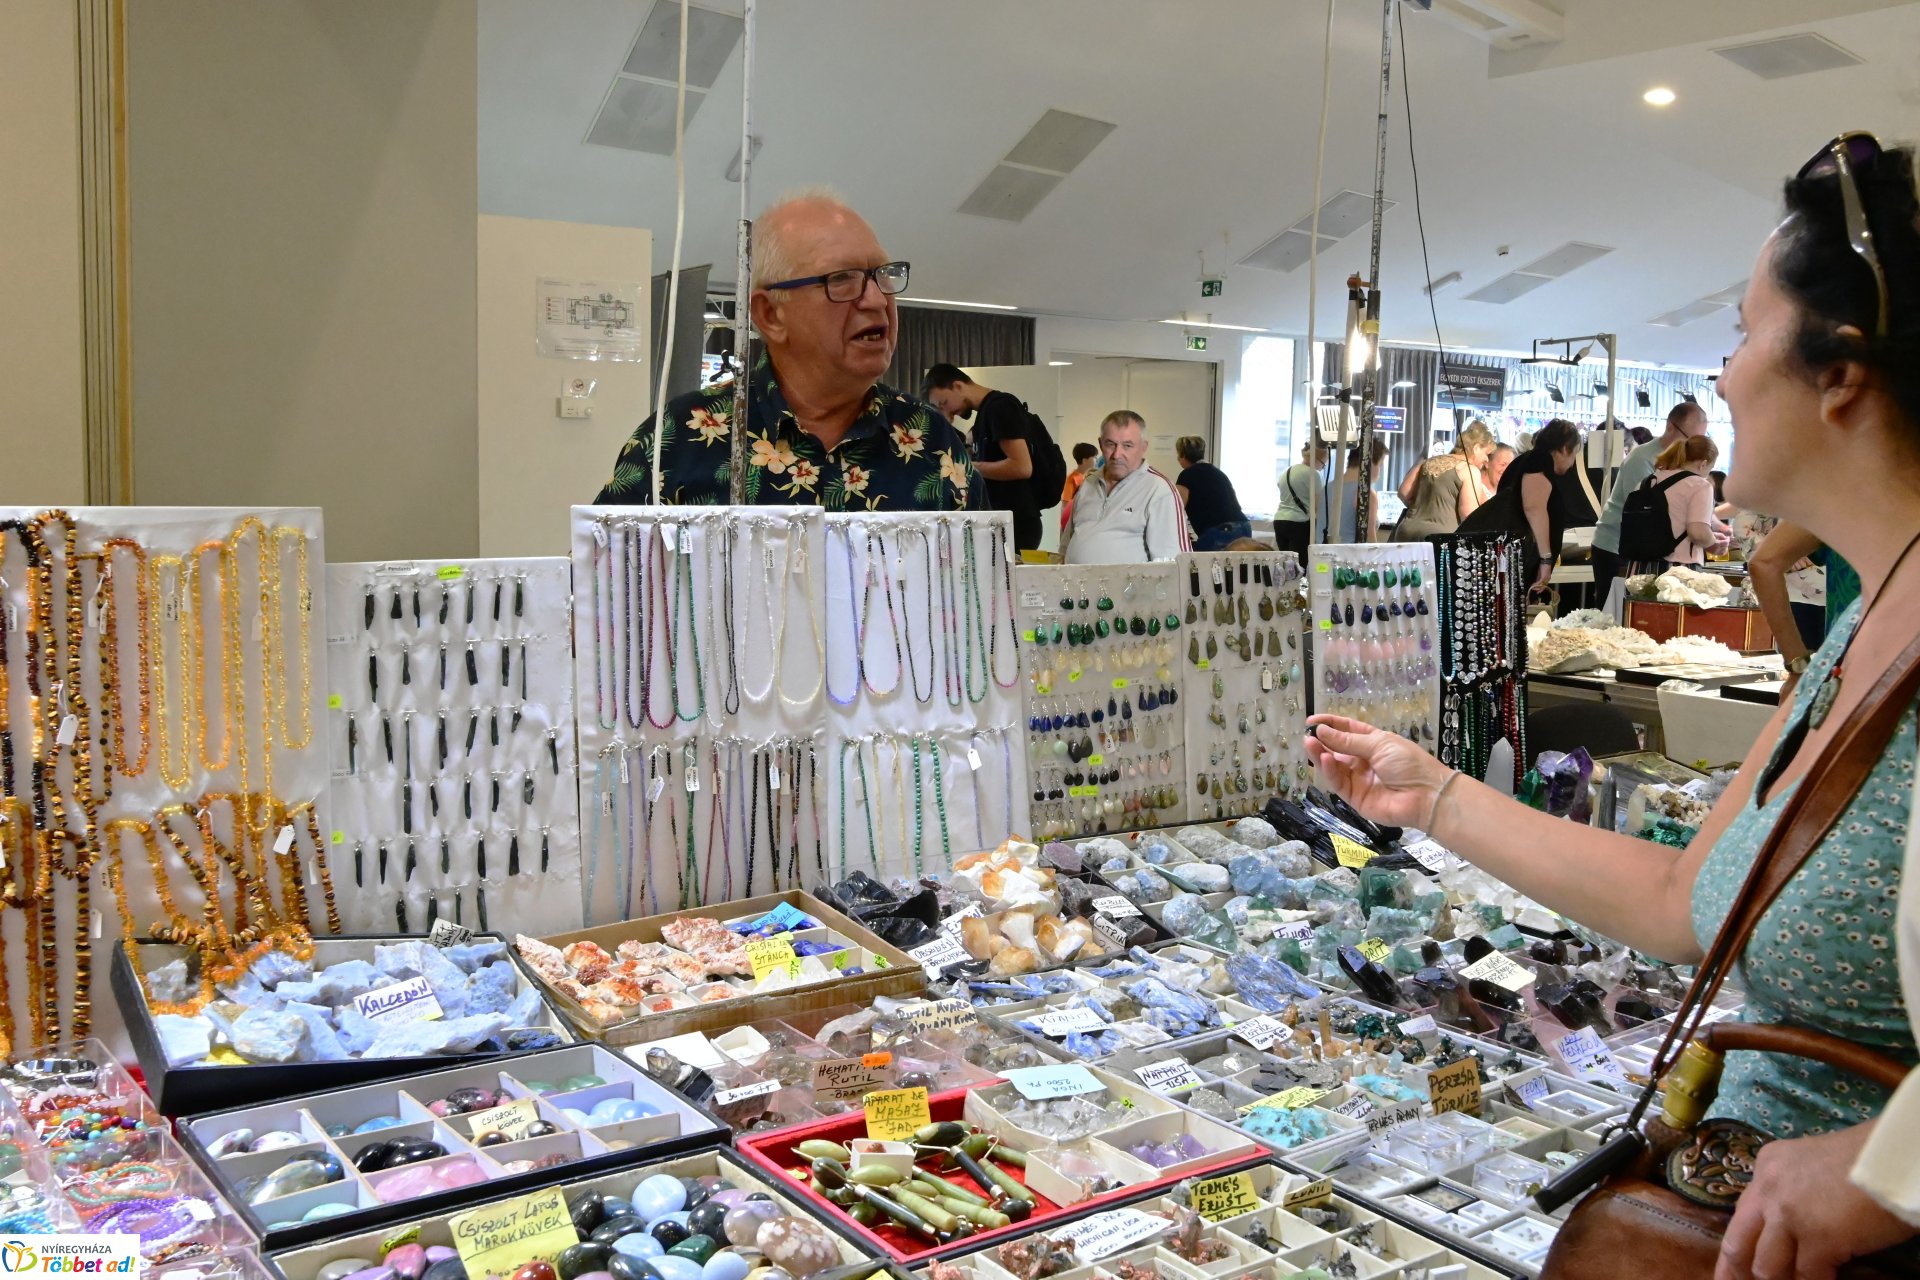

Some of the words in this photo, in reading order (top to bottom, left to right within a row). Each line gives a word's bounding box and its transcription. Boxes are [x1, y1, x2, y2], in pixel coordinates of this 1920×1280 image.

[1440, 374, 1460, 383] EGYEDI
[828, 1073, 876, 1087] RUTIL
[864, 1093, 905, 1106] APARAT
[458, 1211, 519, 1239] CSISZOLT
[473, 1212, 564, 1251] MAROKKÖVEK
